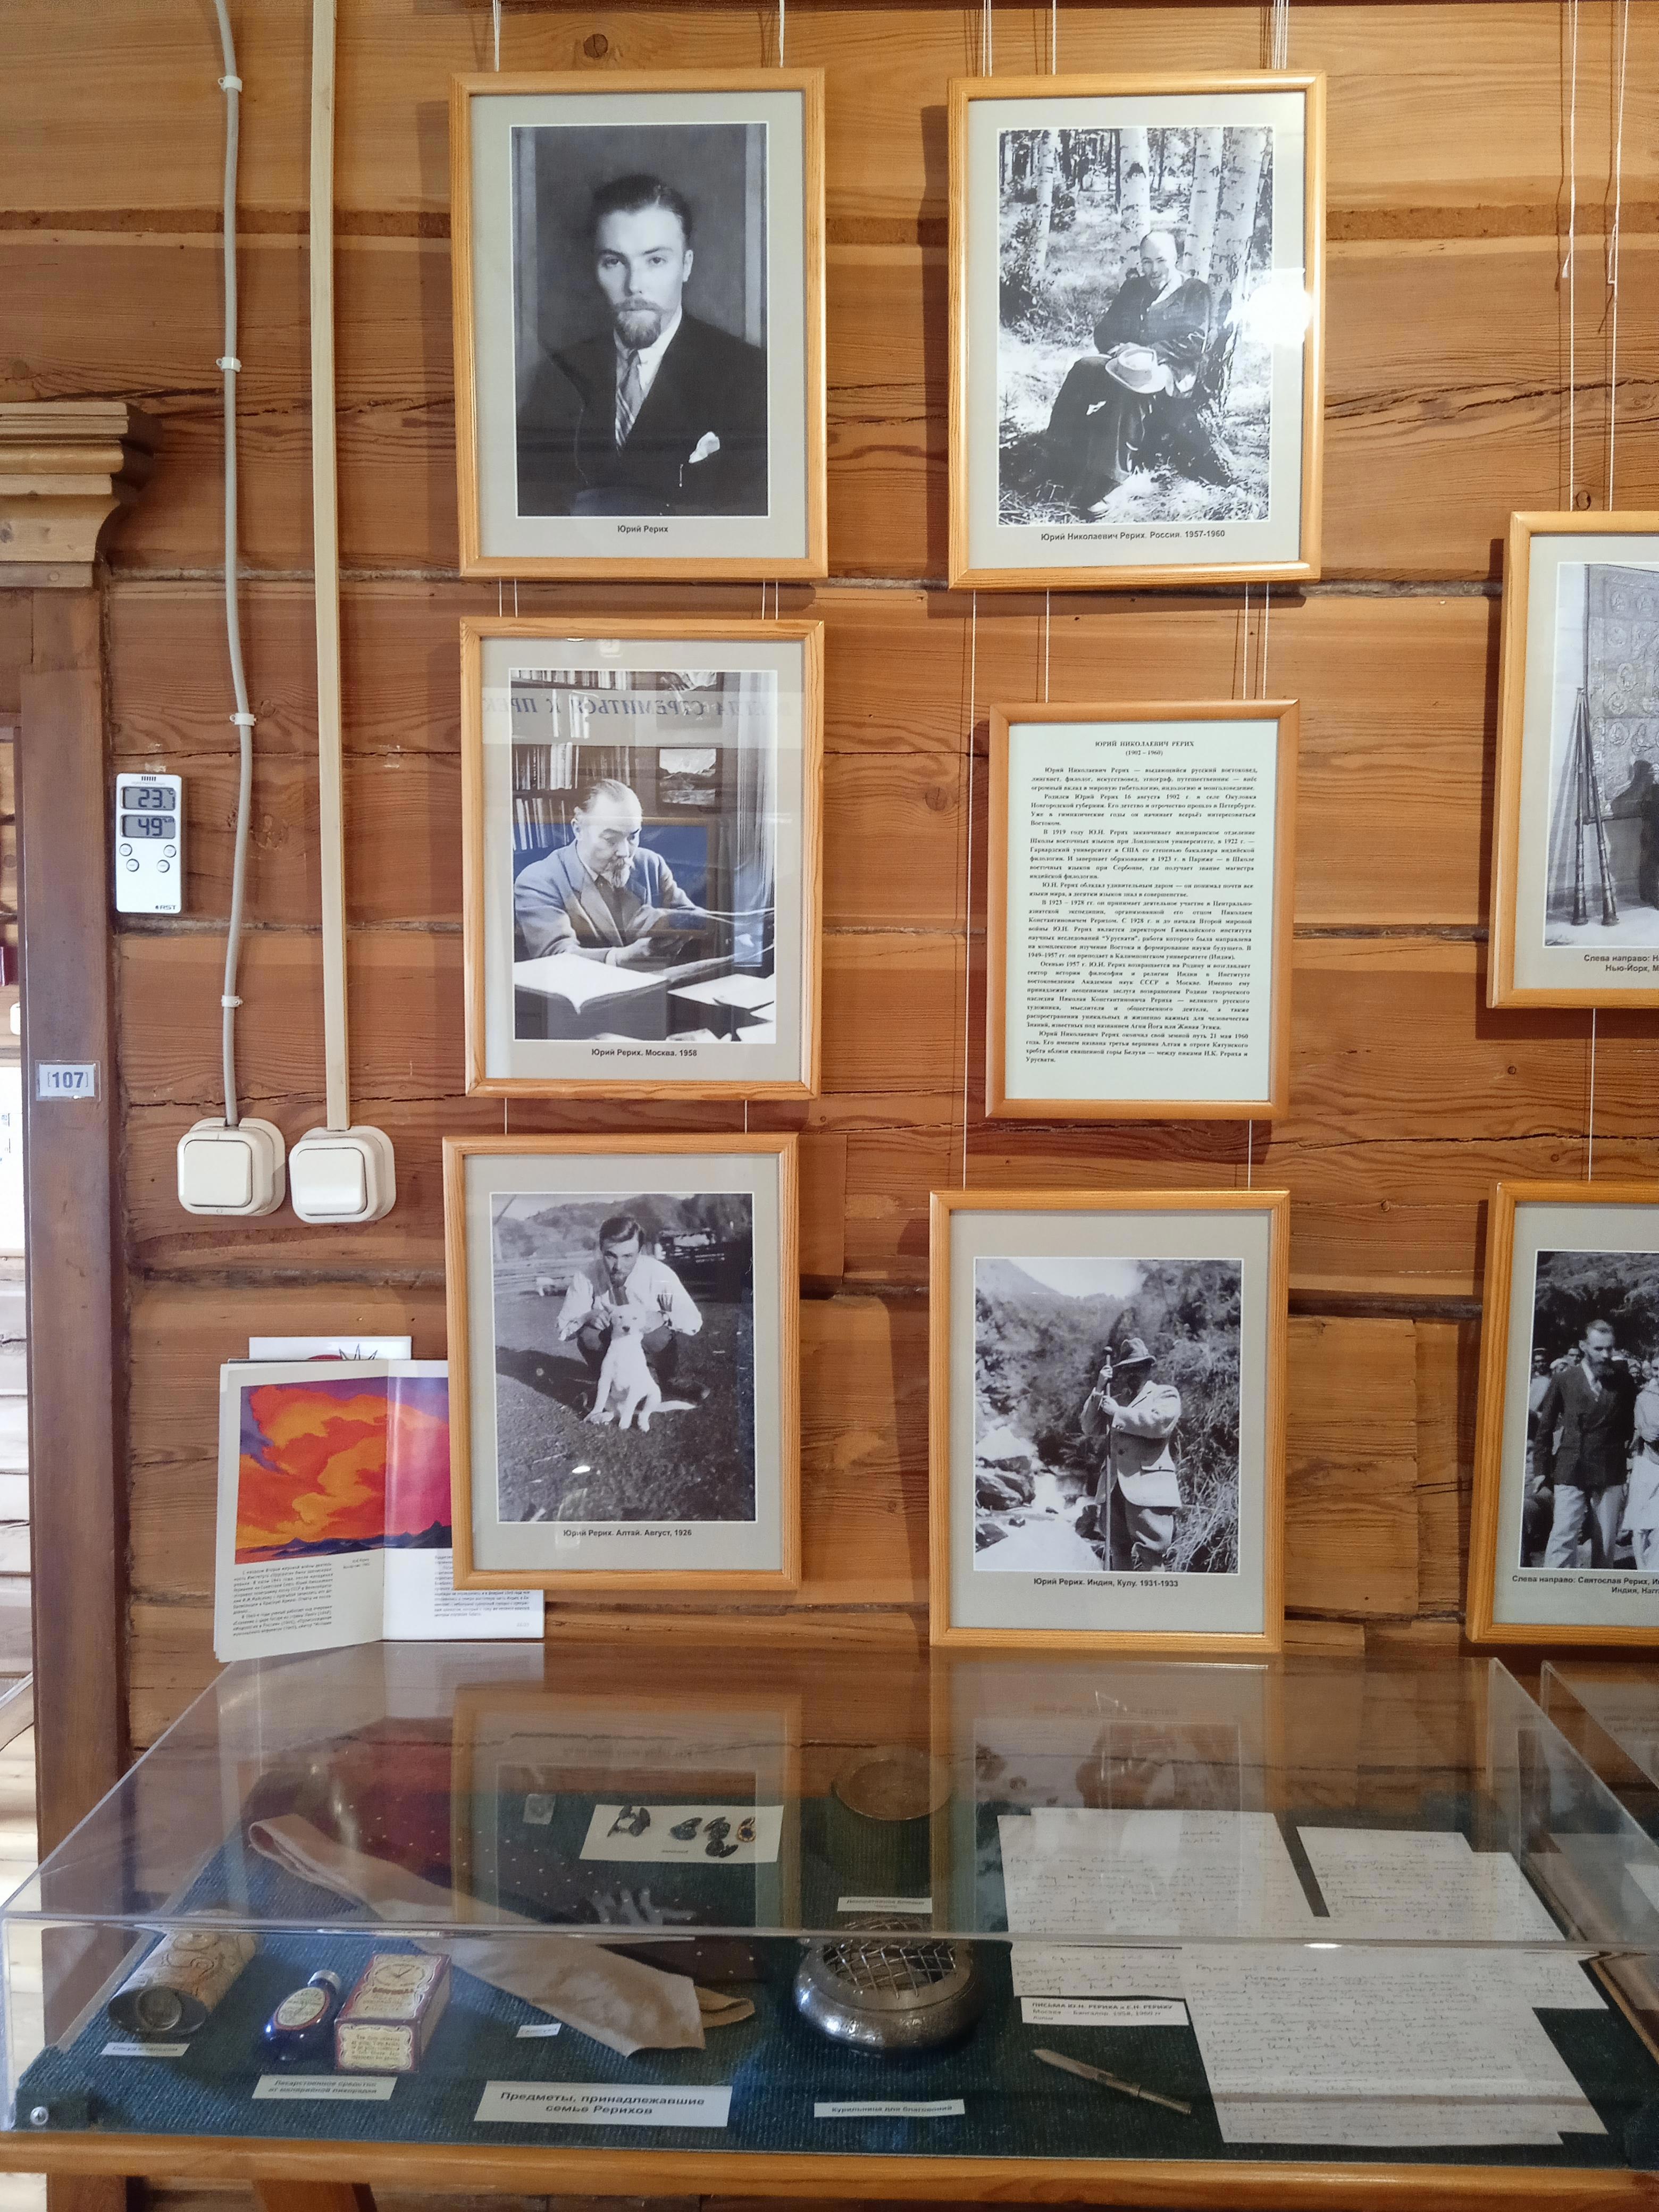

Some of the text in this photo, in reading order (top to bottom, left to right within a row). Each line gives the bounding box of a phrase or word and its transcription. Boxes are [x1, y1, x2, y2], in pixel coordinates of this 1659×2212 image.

[1041, 533, 1065, 541] Юрий
[138, 818, 162, 836] 49
[1117, 1579, 1137, 1588] Кулу.
[500, 2092, 704, 2106] Предметы, принадлежавшие
[593, 2106, 652, 2115] Рерихов
